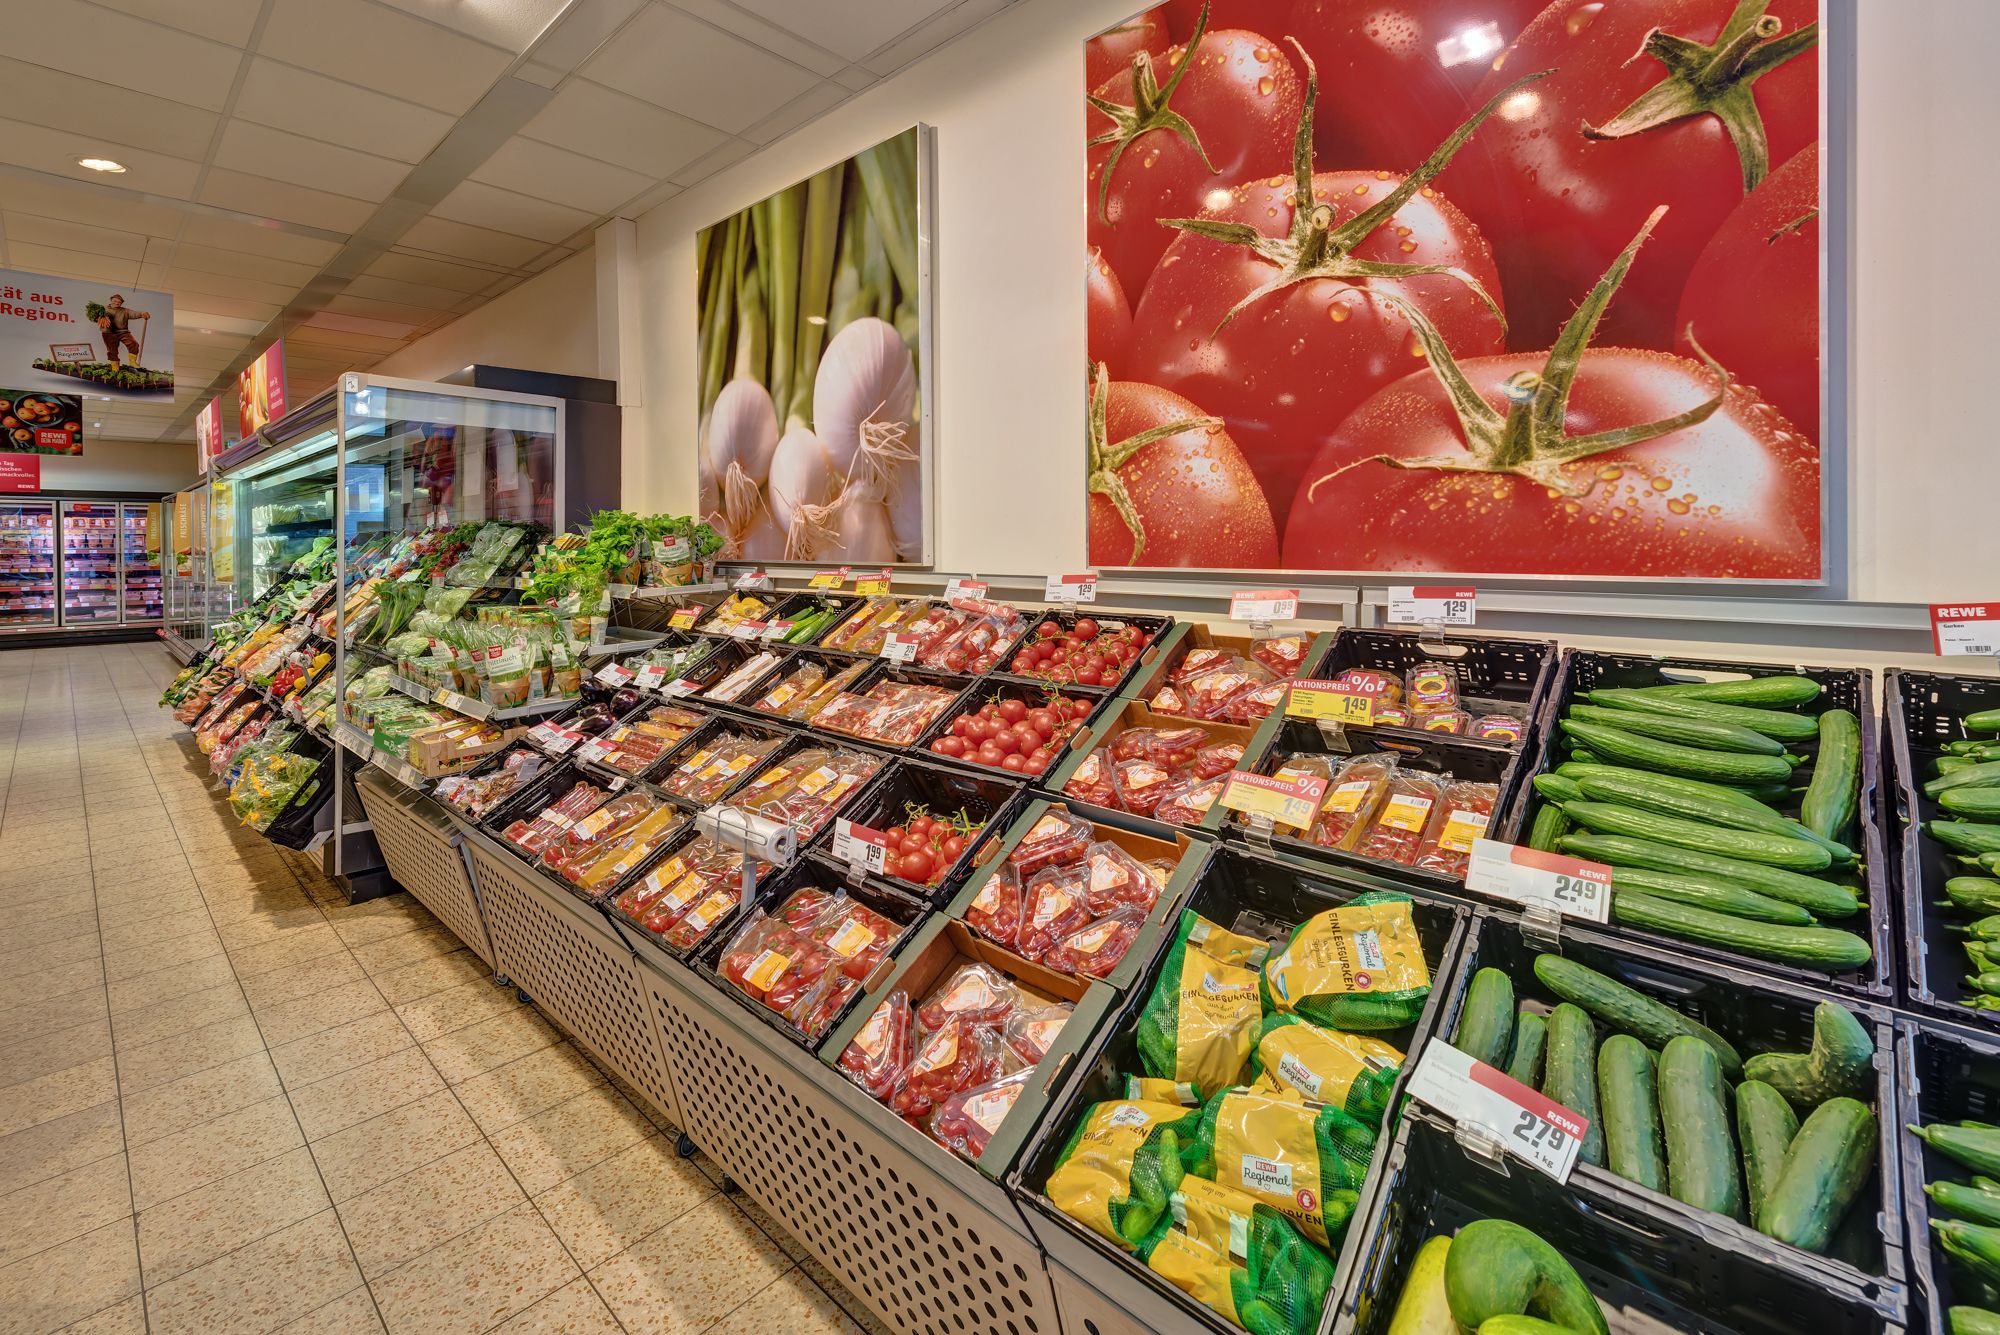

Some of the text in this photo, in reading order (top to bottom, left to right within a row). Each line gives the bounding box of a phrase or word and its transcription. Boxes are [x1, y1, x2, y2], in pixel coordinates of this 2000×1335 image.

[30, 292, 64, 306] aus
[0, 302, 75, 323] Region.
[41, 432, 67, 440] REWE
[882, 570, 891, 578] %
[1078, 584, 1092, 596] 1.29
[1273, 601, 1293, 614] 0.99
[1443, 601, 1467, 616] 1.29
[1938, 607, 1987, 618] REWE
[1292, 676, 1375, 692] AKTIONSPREIS %
[1343, 697, 1367, 714] 1.49
[1233, 773, 1295, 792] AKTIONSPREIS
[1298, 778, 1321, 797] %
[1284, 798, 1311, 816] 1.49
[866, 844, 881, 862] 1.99
[1579, 869, 1607, 881] REWE
[1554, 876, 1597, 902] 2.49
[1360, 933, 1376, 969] Regional
[1280, 1061, 1317, 1095] Regional
[1512, 1110, 1566, 1151] 2.79
[1547, 1110, 1581, 1135] REWE
[1257, 1161, 1277, 1173] REWE
[1542, 1155, 1554, 1169] kg
[1243, 1167, 1291, 1187] Regional
